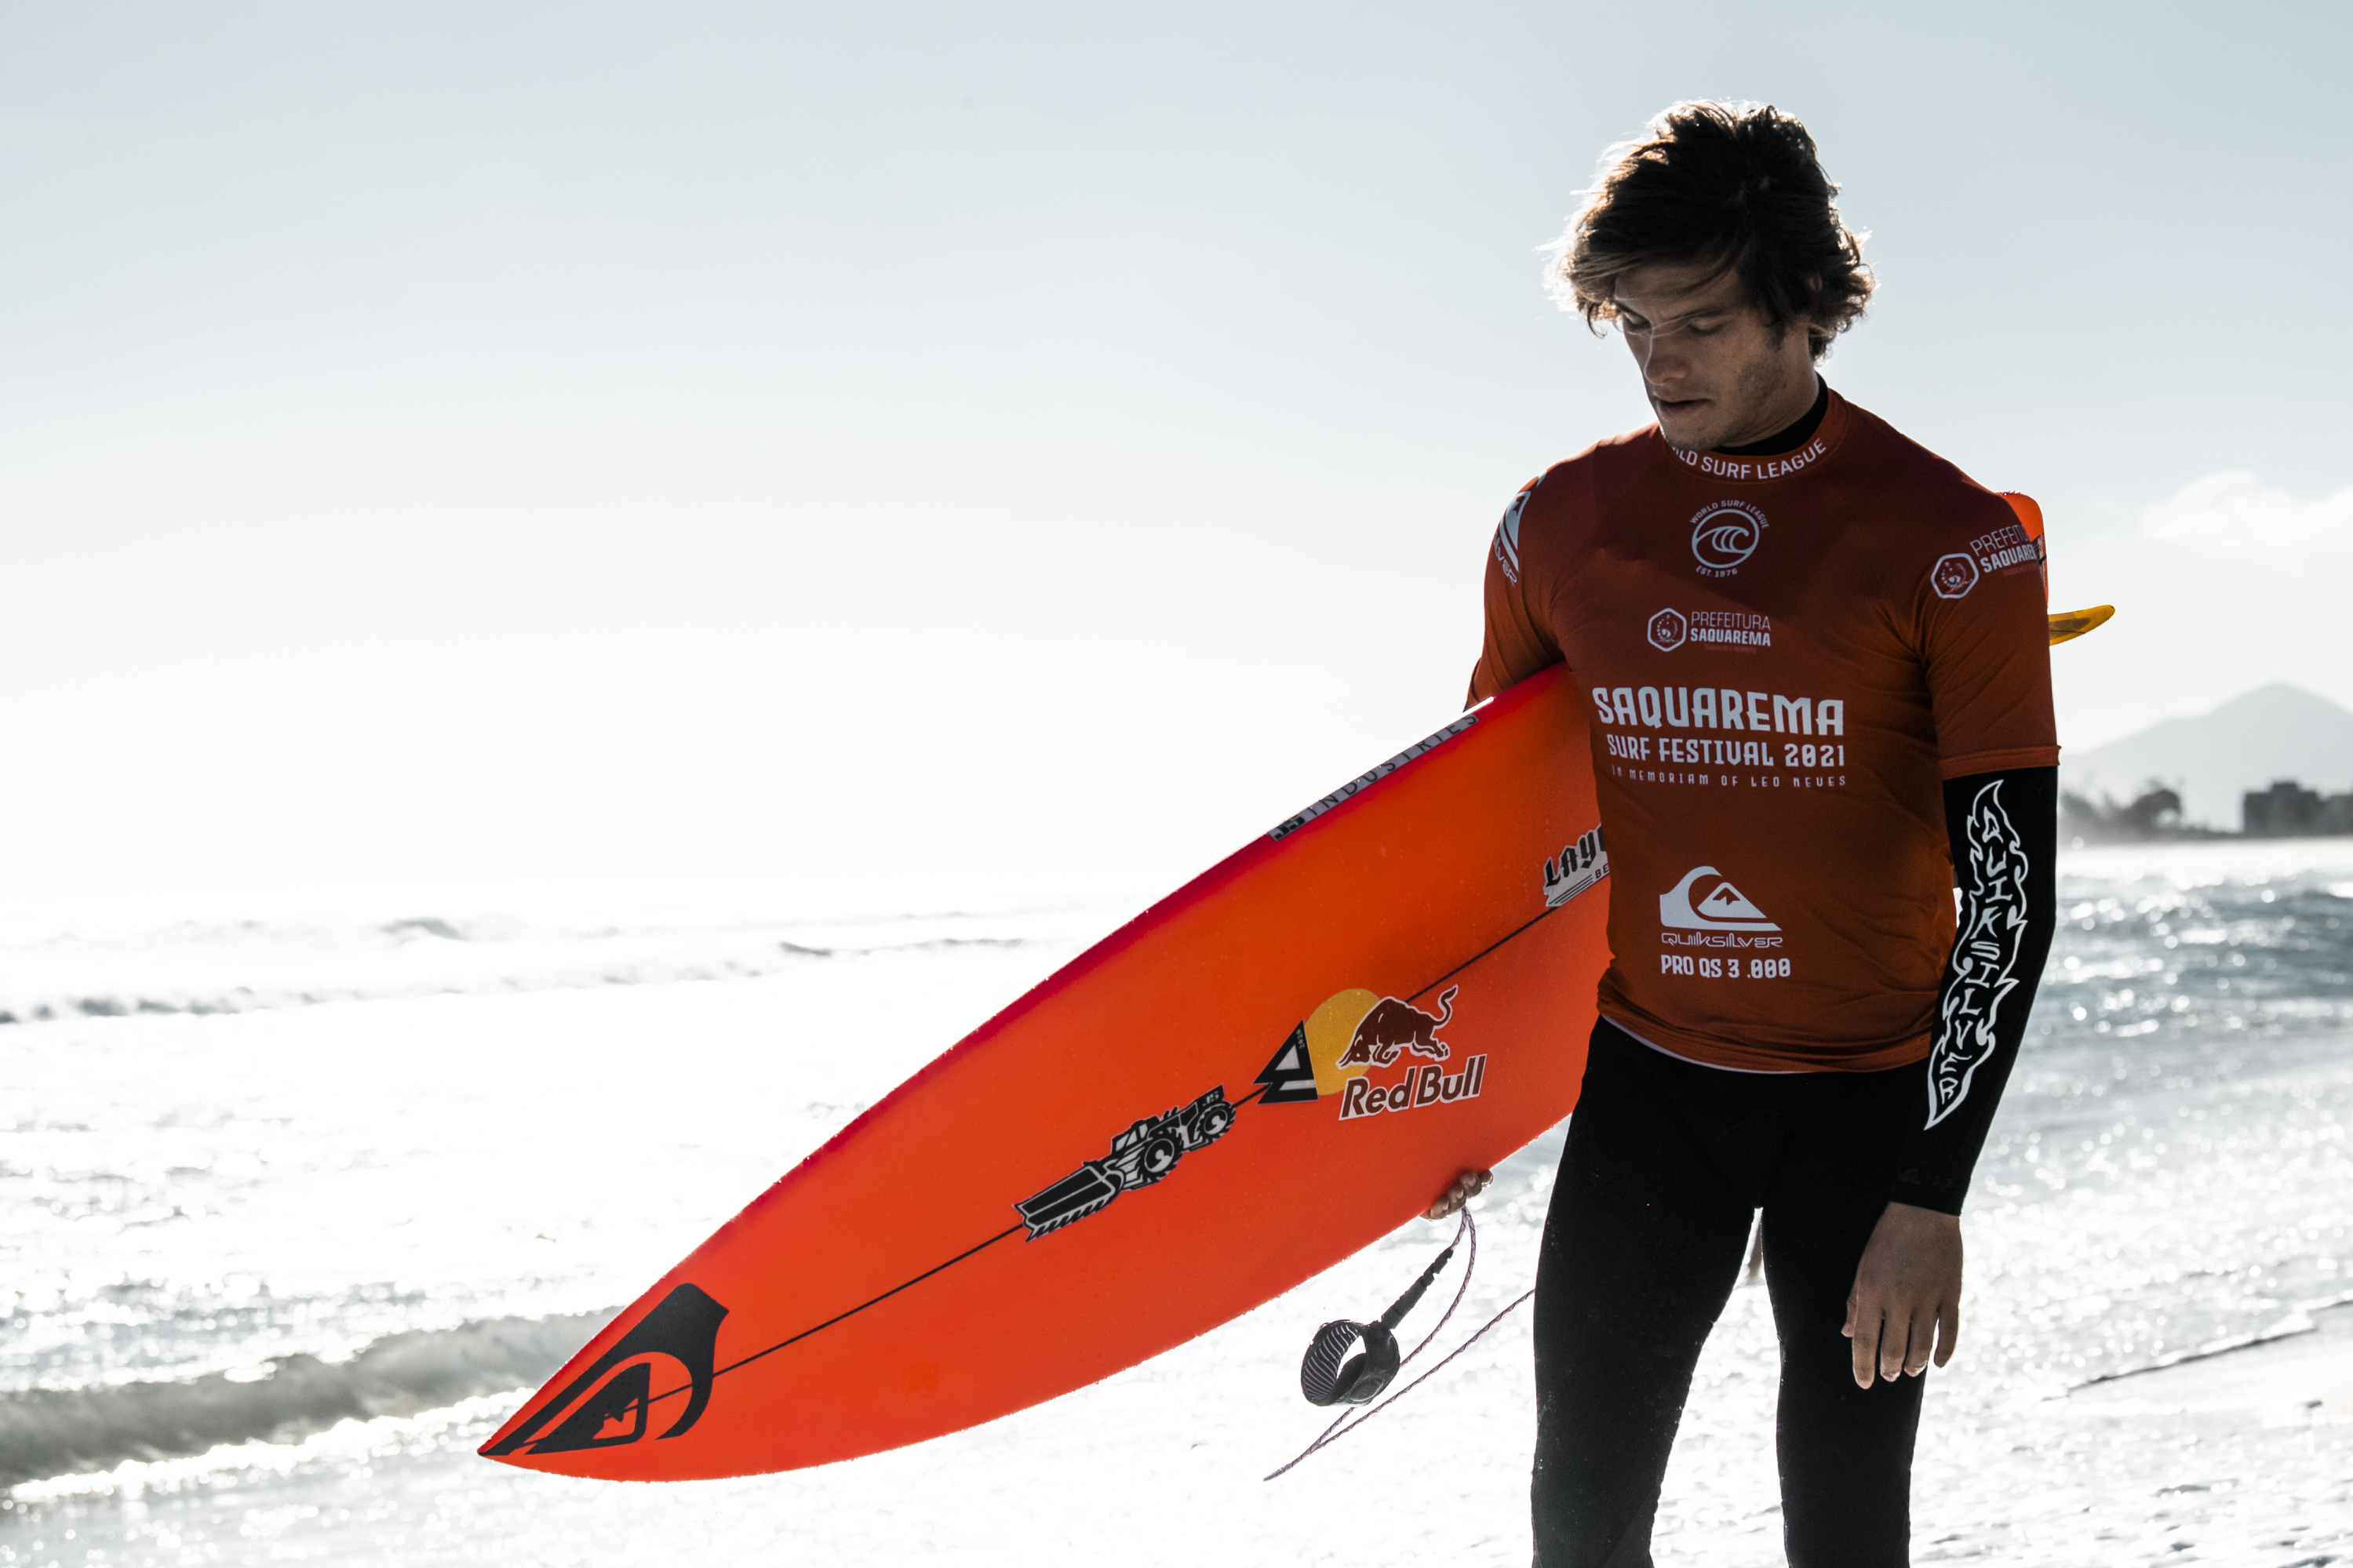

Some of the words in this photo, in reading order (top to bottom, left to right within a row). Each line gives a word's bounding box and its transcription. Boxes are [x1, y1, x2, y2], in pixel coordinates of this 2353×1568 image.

[1700, 456, 1751, 479] SURF
[1757, 438, 1827, 479] LEAGUE
[1689, 502, 1719, 524] WORLD
[1721, 500, 1746, 508] SURF
[1746, 504, 1770, 529] LEAGUE
[1696, 565, 1712, 577] EST.
[1714, 567, 1738, 578] 1976
[1691, 610, 1772, 631] PREFEITURA
[1690, 628, 1772, 647] SAQUAREMA
[1591, 686, 1844, 736] SAQUAREMA
[1306, 714, 1477, 816] INDUSTRIES
[1606, 733, 1651, 761] SURF
[1659, 737, 1774, 766] FESTIVAL
[1784, 743, 1845, 767] 2021
[1612, 765, 1623, 777] IN
[1629, 769, 1709, 785] MEMORIAM
[1721, 775, 1738, 786] OF
[1750, 776, 1779, 788] LEO
[1793, 775, 1845, 788] NEVES
[1660, 954, 1695, 976] PRO
[1698, 957, 1723, 979] QS
[1940, 806, 2013, 1106] QUIKSILVER
[1339, 1066, 1417, 1119] Red
[1414, 1054, 1487, 1107] Bull
